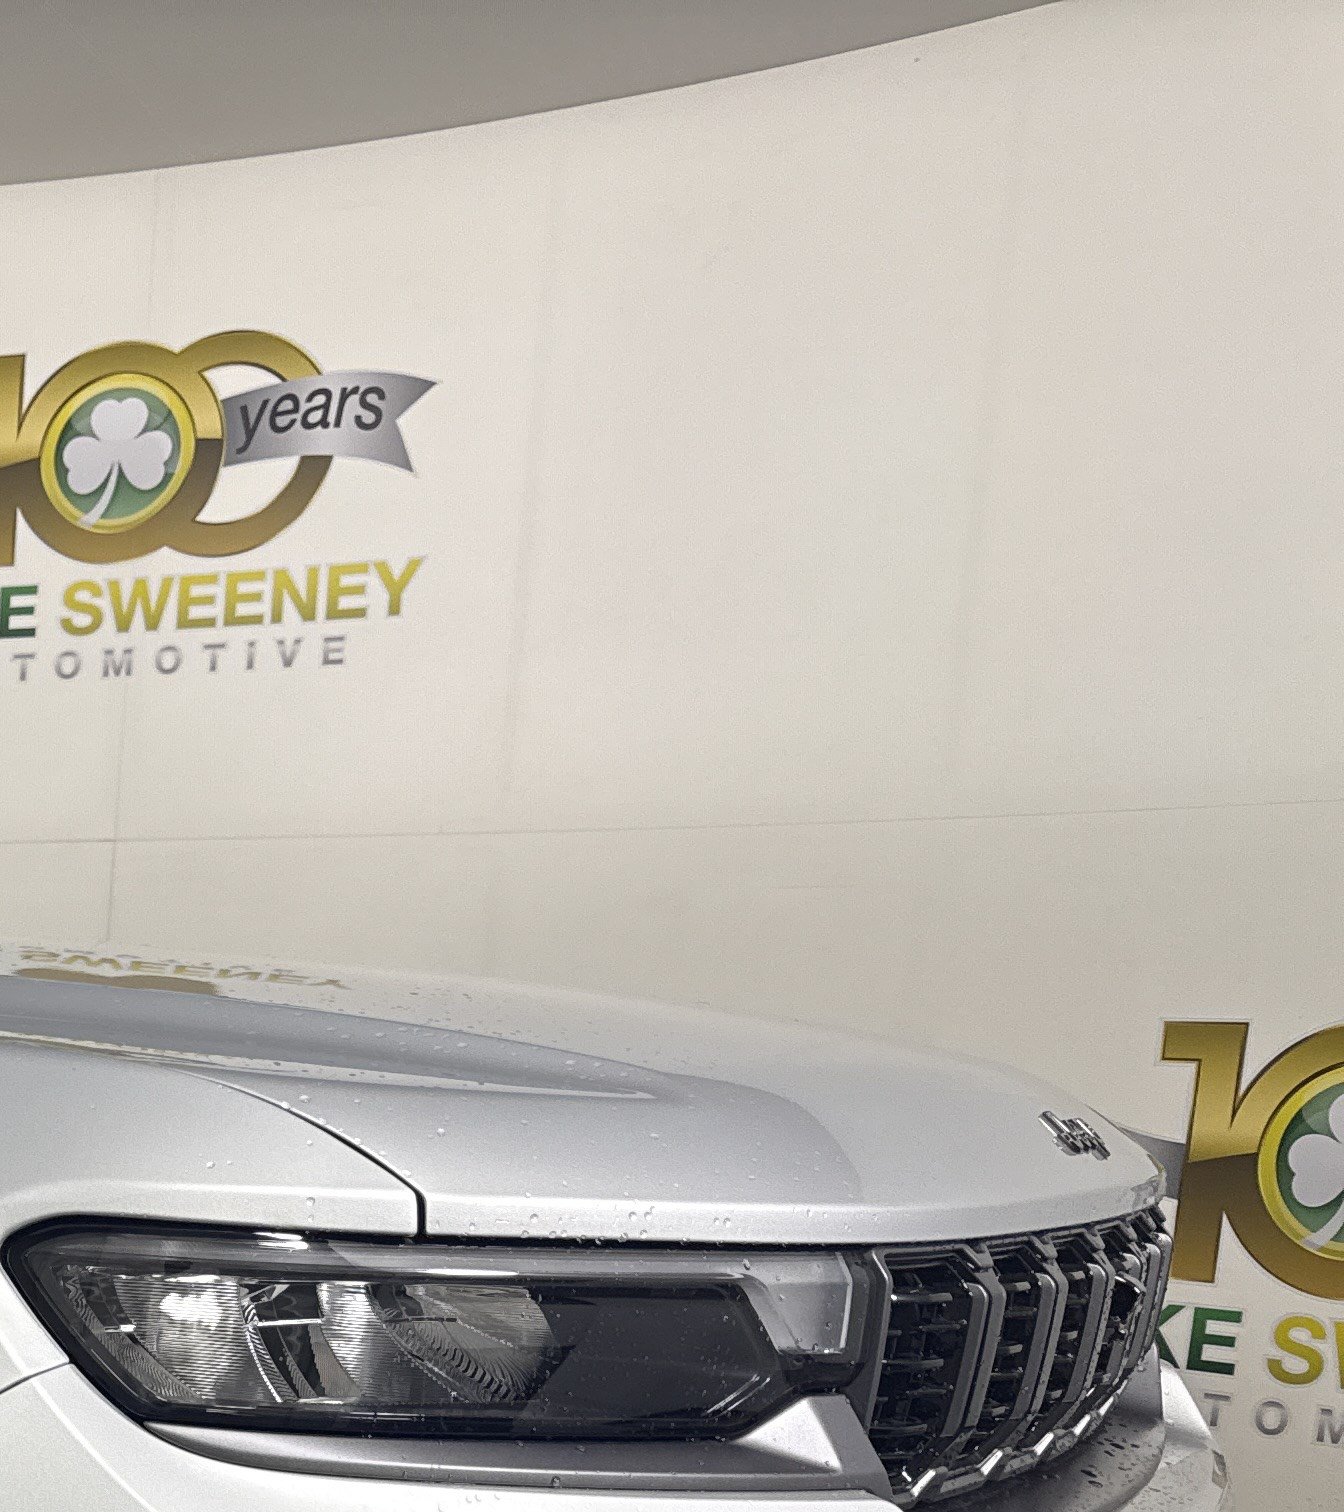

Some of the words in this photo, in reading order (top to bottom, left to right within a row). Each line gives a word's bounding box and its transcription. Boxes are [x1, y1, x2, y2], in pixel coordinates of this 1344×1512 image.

[235, 380, 387, 456] years
[59, 556, 426, 638] SWEENEY
[1266, 1315, 1344, 1390] S
